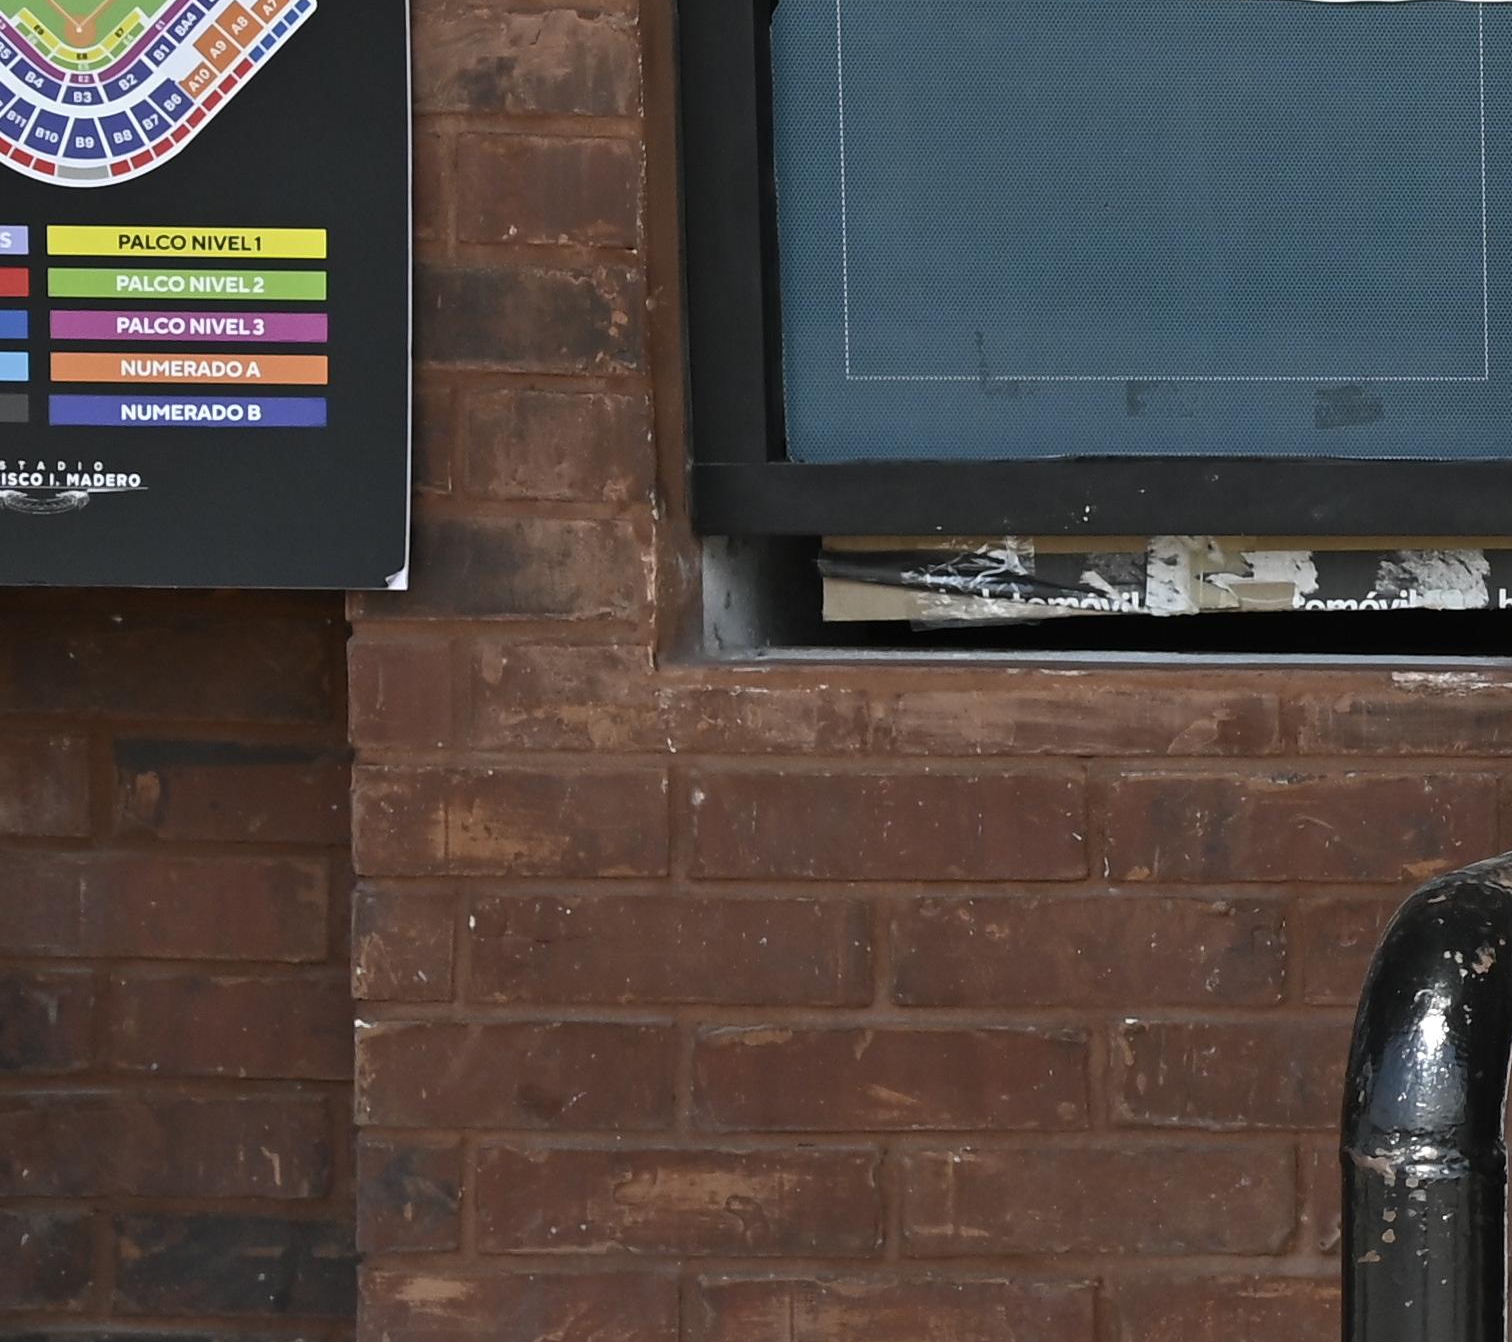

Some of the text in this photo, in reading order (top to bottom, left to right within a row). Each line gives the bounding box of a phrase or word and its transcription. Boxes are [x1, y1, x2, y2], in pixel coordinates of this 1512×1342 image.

[174, 11, 198, 38] BA4
[231, 16, 249, 36] A8
[152, 43, 171, 61] B1
[208, 39, 228, 60] A9
[24, 71, 44, 89] B4
[118, 73, 138, 91] B2
[187, 69, 211, 92] A10
[73, 90, 92, 103] B3
[163, 93, 182, 113] B6
[6, 109, 27, 128] B11
[141, 114, 160, 131] B7
[35, 127, 60, 144] B10
[75, 136, 95, 149] B9
[113, 129, 133, 145] B8
[118, 234, 262, 252] PALCO NIVEL 1
[116, 275, 265, 293] PALCO NIVEL 2
[116, 317, 265, 336] PALCO NIVEL 3
[120, 360, 261, 378] NUMERADO A
[120, 403, 262, 421] NUMERADO B
[66, 473, 141, 487] MADERO
